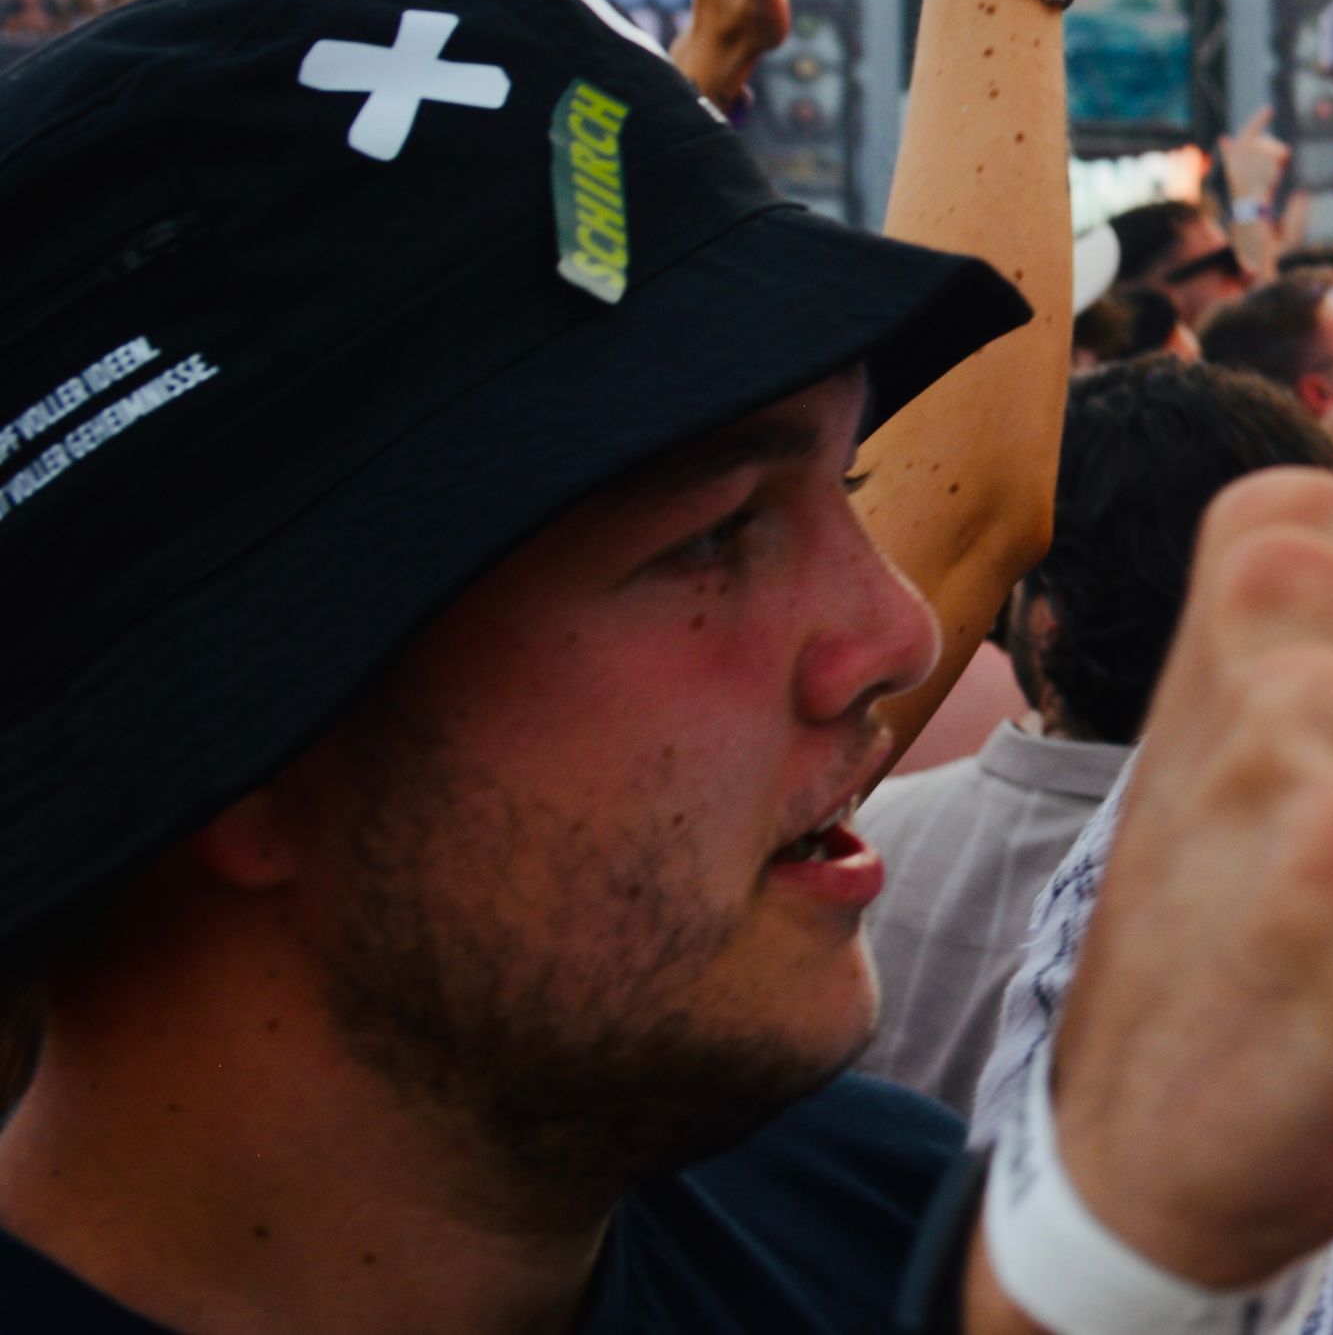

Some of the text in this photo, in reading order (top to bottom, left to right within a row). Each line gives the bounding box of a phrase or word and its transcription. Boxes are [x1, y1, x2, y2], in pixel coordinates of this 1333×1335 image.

[567, 83, 631, 290] SCHIRCH
[14, 376, 90, 440] VOLLER
[81, 335, 162, 395] IDEEN.
[4, 442, 73, 505] VOLLER
